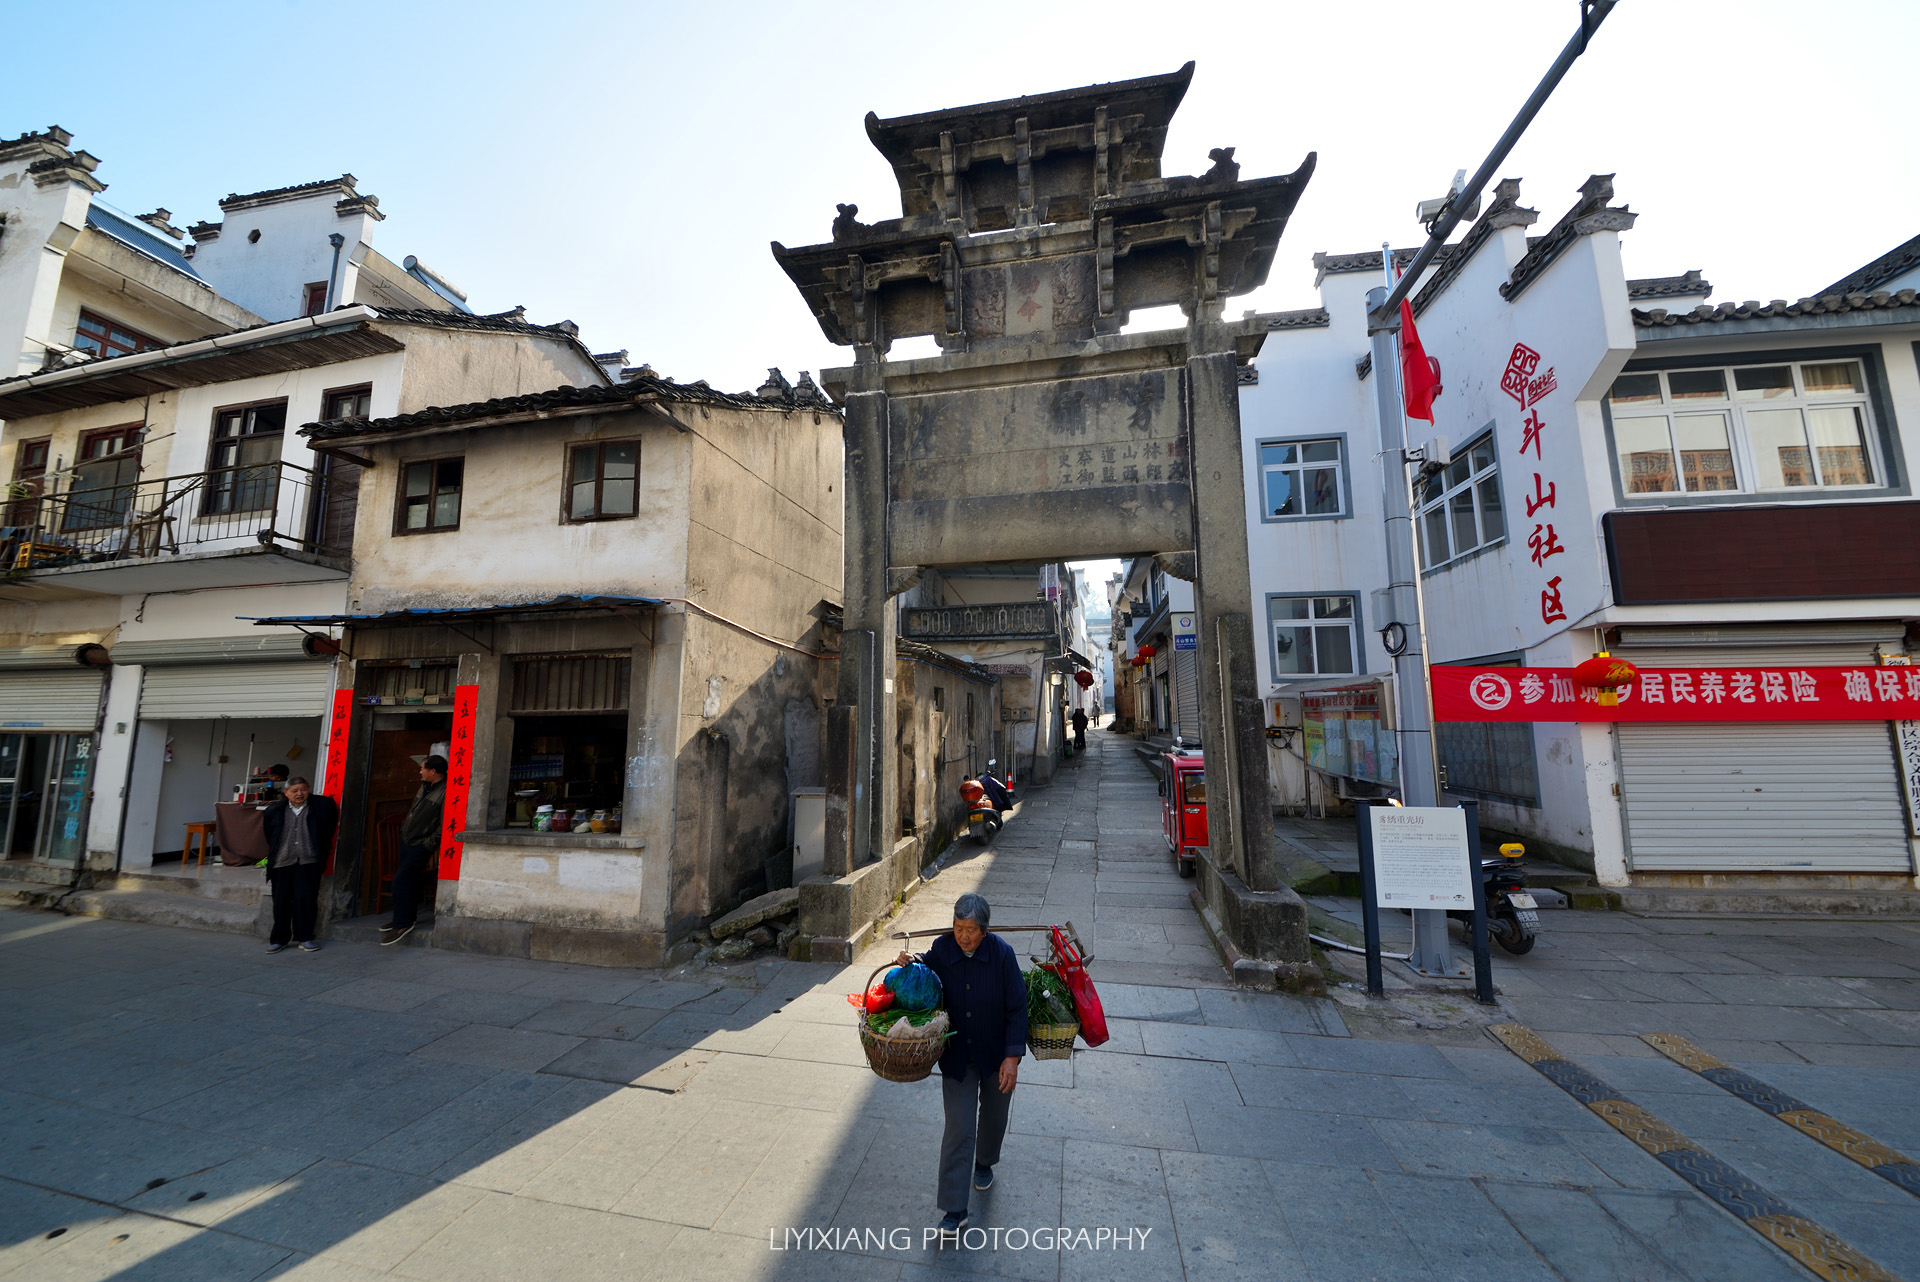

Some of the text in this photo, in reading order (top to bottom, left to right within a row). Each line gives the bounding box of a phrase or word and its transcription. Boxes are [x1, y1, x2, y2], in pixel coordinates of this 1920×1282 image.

[1519, 408, 1567, 625] 斗山社区
[1606, 662, 1635, 683] 福
[64, 738, 91, 839] 设计订做
